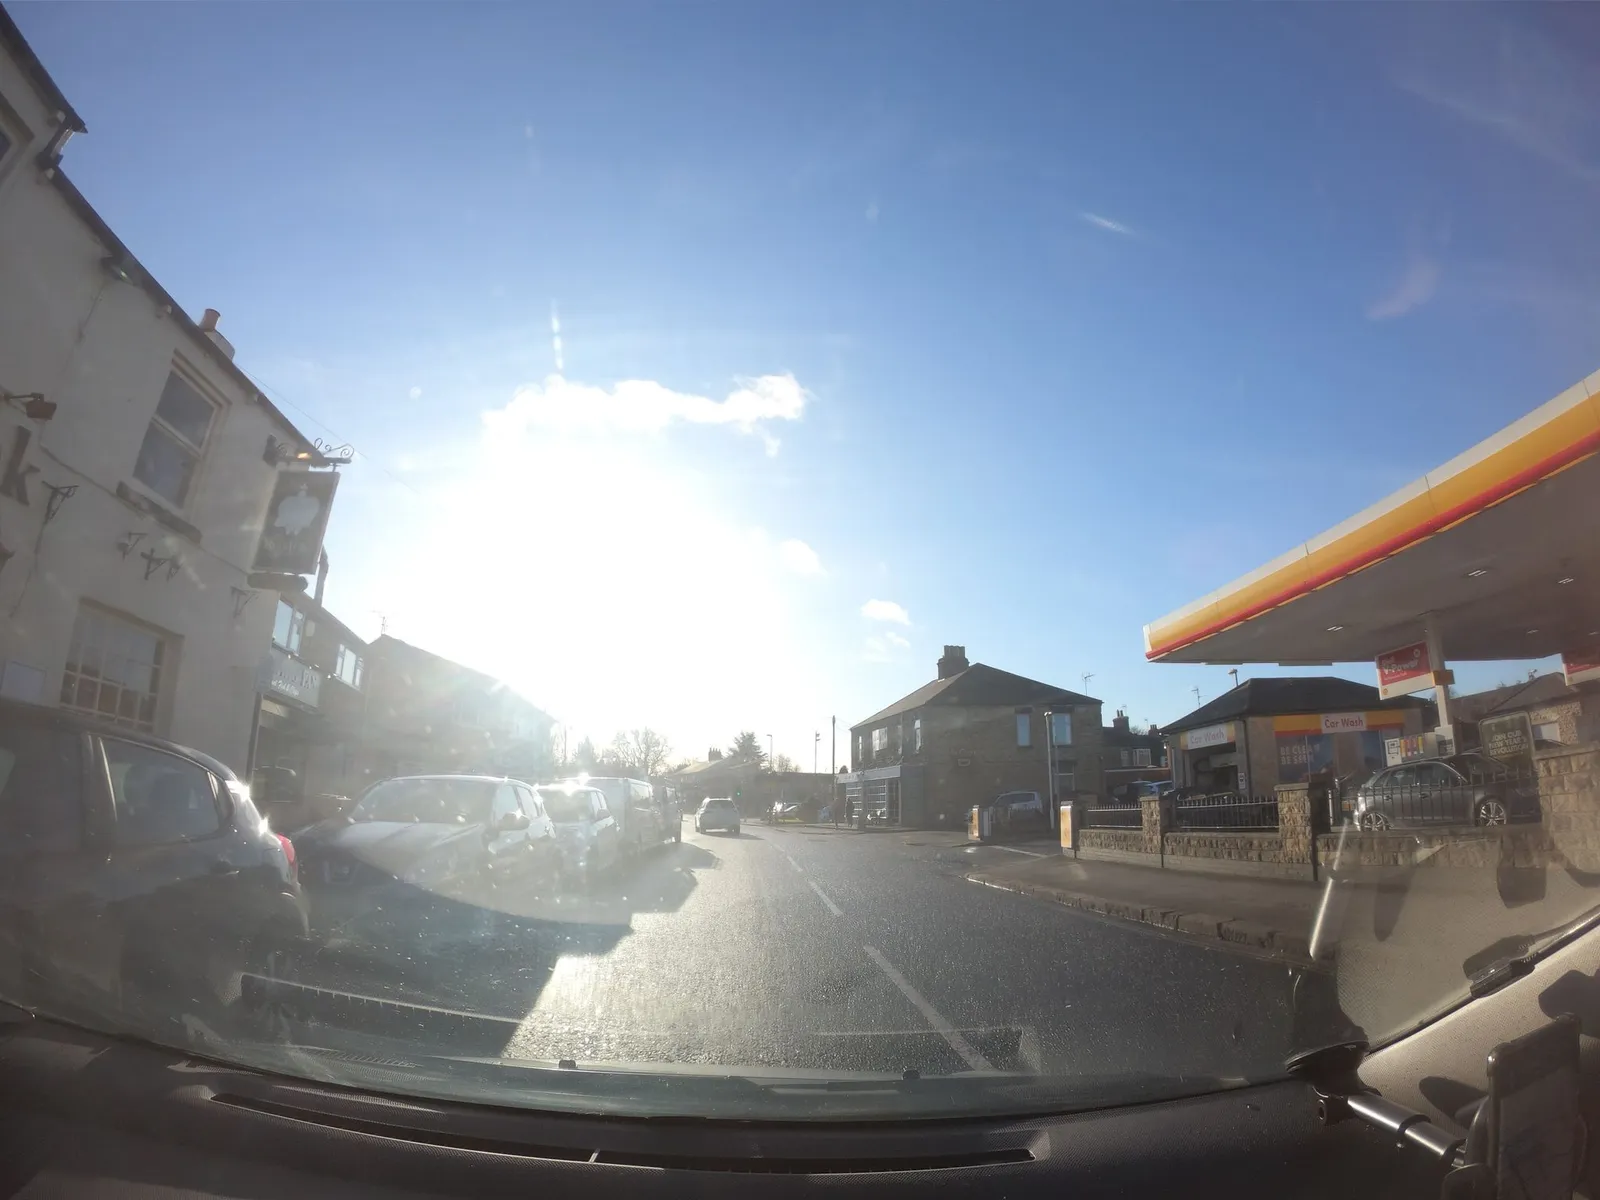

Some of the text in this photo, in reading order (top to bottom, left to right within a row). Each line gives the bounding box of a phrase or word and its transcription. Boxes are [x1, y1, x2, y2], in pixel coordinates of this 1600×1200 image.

[1324, 716, 1364, 728] Car Wash
[1204, 727, 1225, 742] Wash
